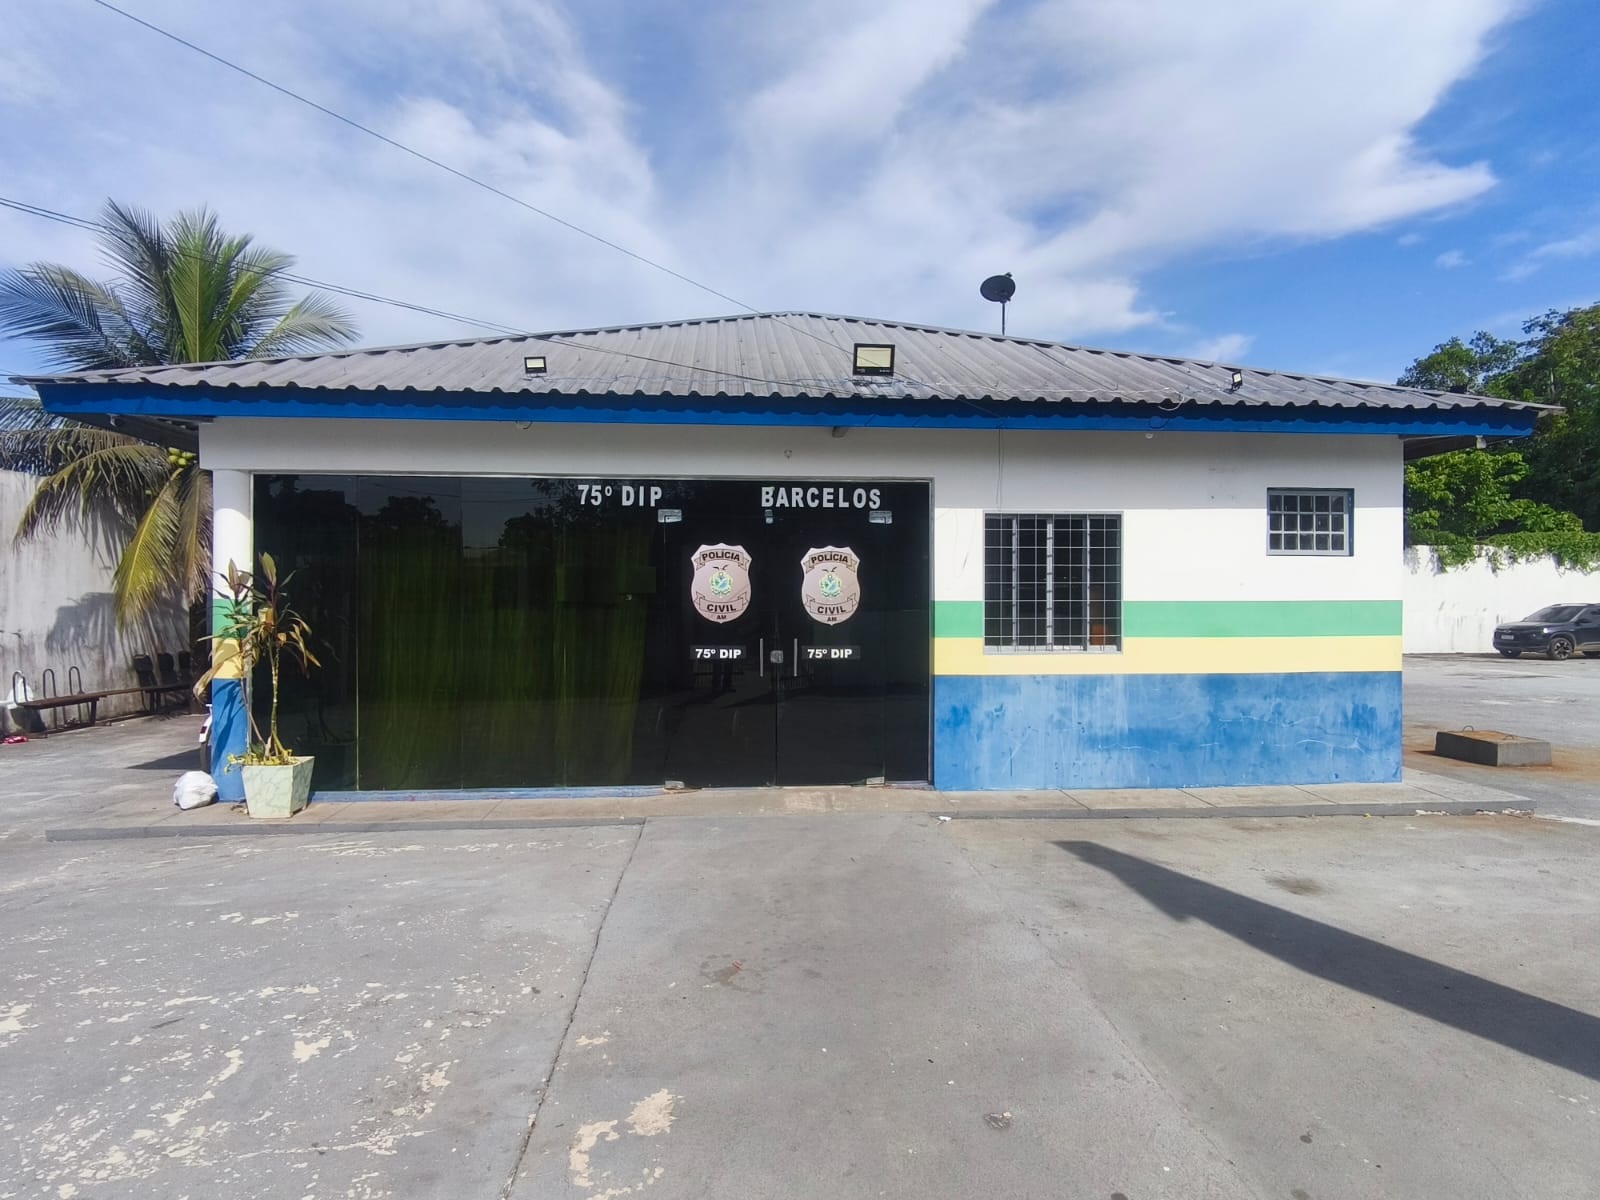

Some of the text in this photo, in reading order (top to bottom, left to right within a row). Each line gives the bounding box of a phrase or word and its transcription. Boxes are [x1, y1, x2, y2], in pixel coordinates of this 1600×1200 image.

[621, 486, 662, 506] DIP
[761, 487, 881, 508] BARCELOS
[706, 604, 736, 612] CIVIL
[817, 606, 846, 615] CIVIL
[719, 649, 741, 659] DIP
[830, 649, 853, 659] DIP
